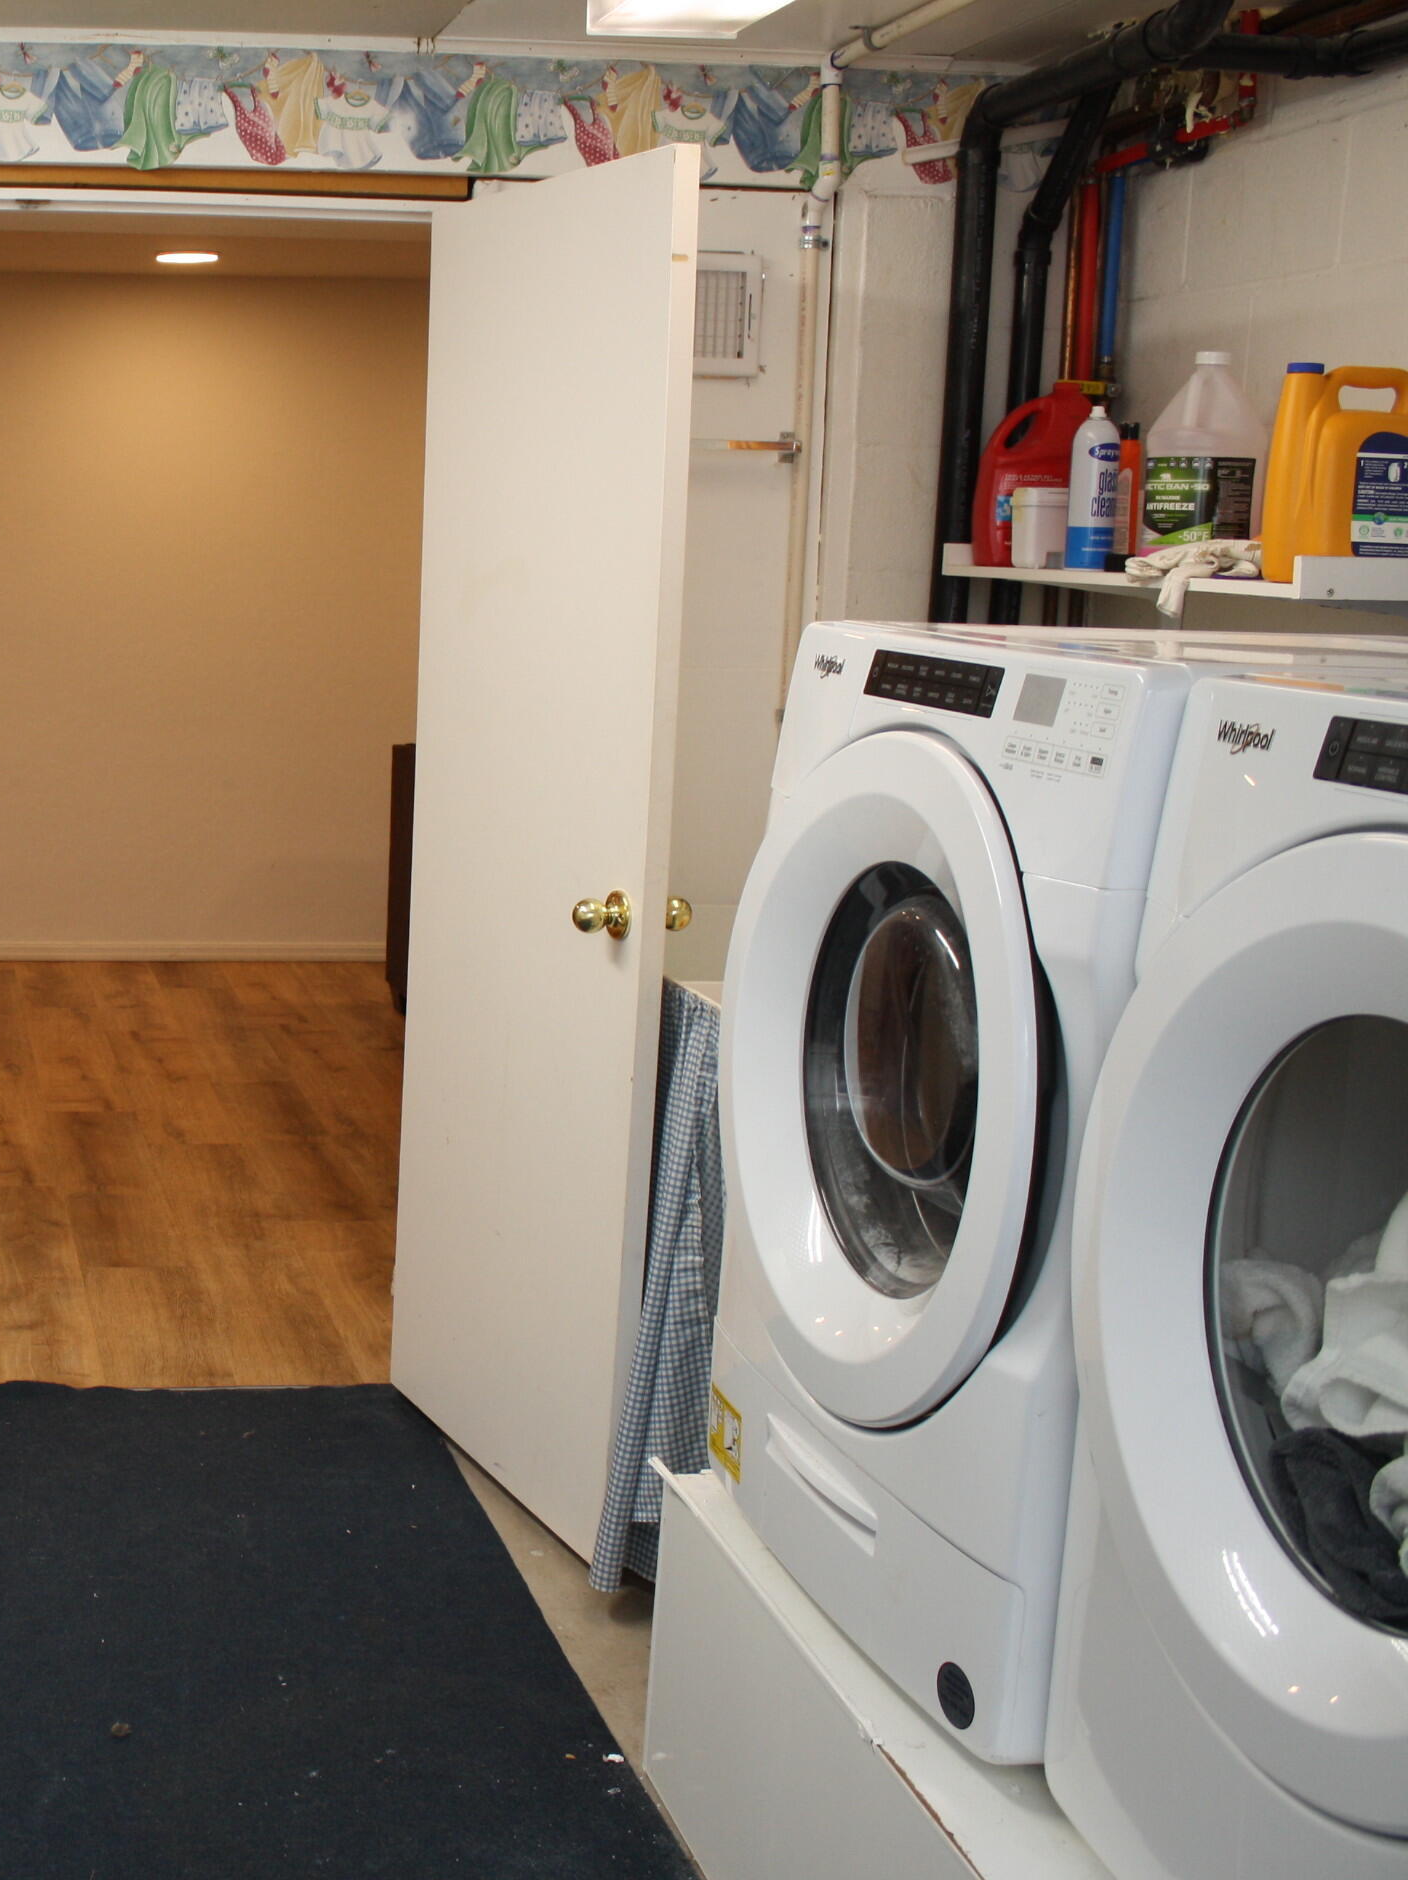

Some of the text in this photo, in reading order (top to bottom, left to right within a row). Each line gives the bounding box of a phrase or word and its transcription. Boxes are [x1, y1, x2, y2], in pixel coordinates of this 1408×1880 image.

[1146, 502, 1196, 511] ANTIFREEZE
[814, 653, 846, 678] Whirlpool
[1217, 720, 1276, 754] Whirlpool
